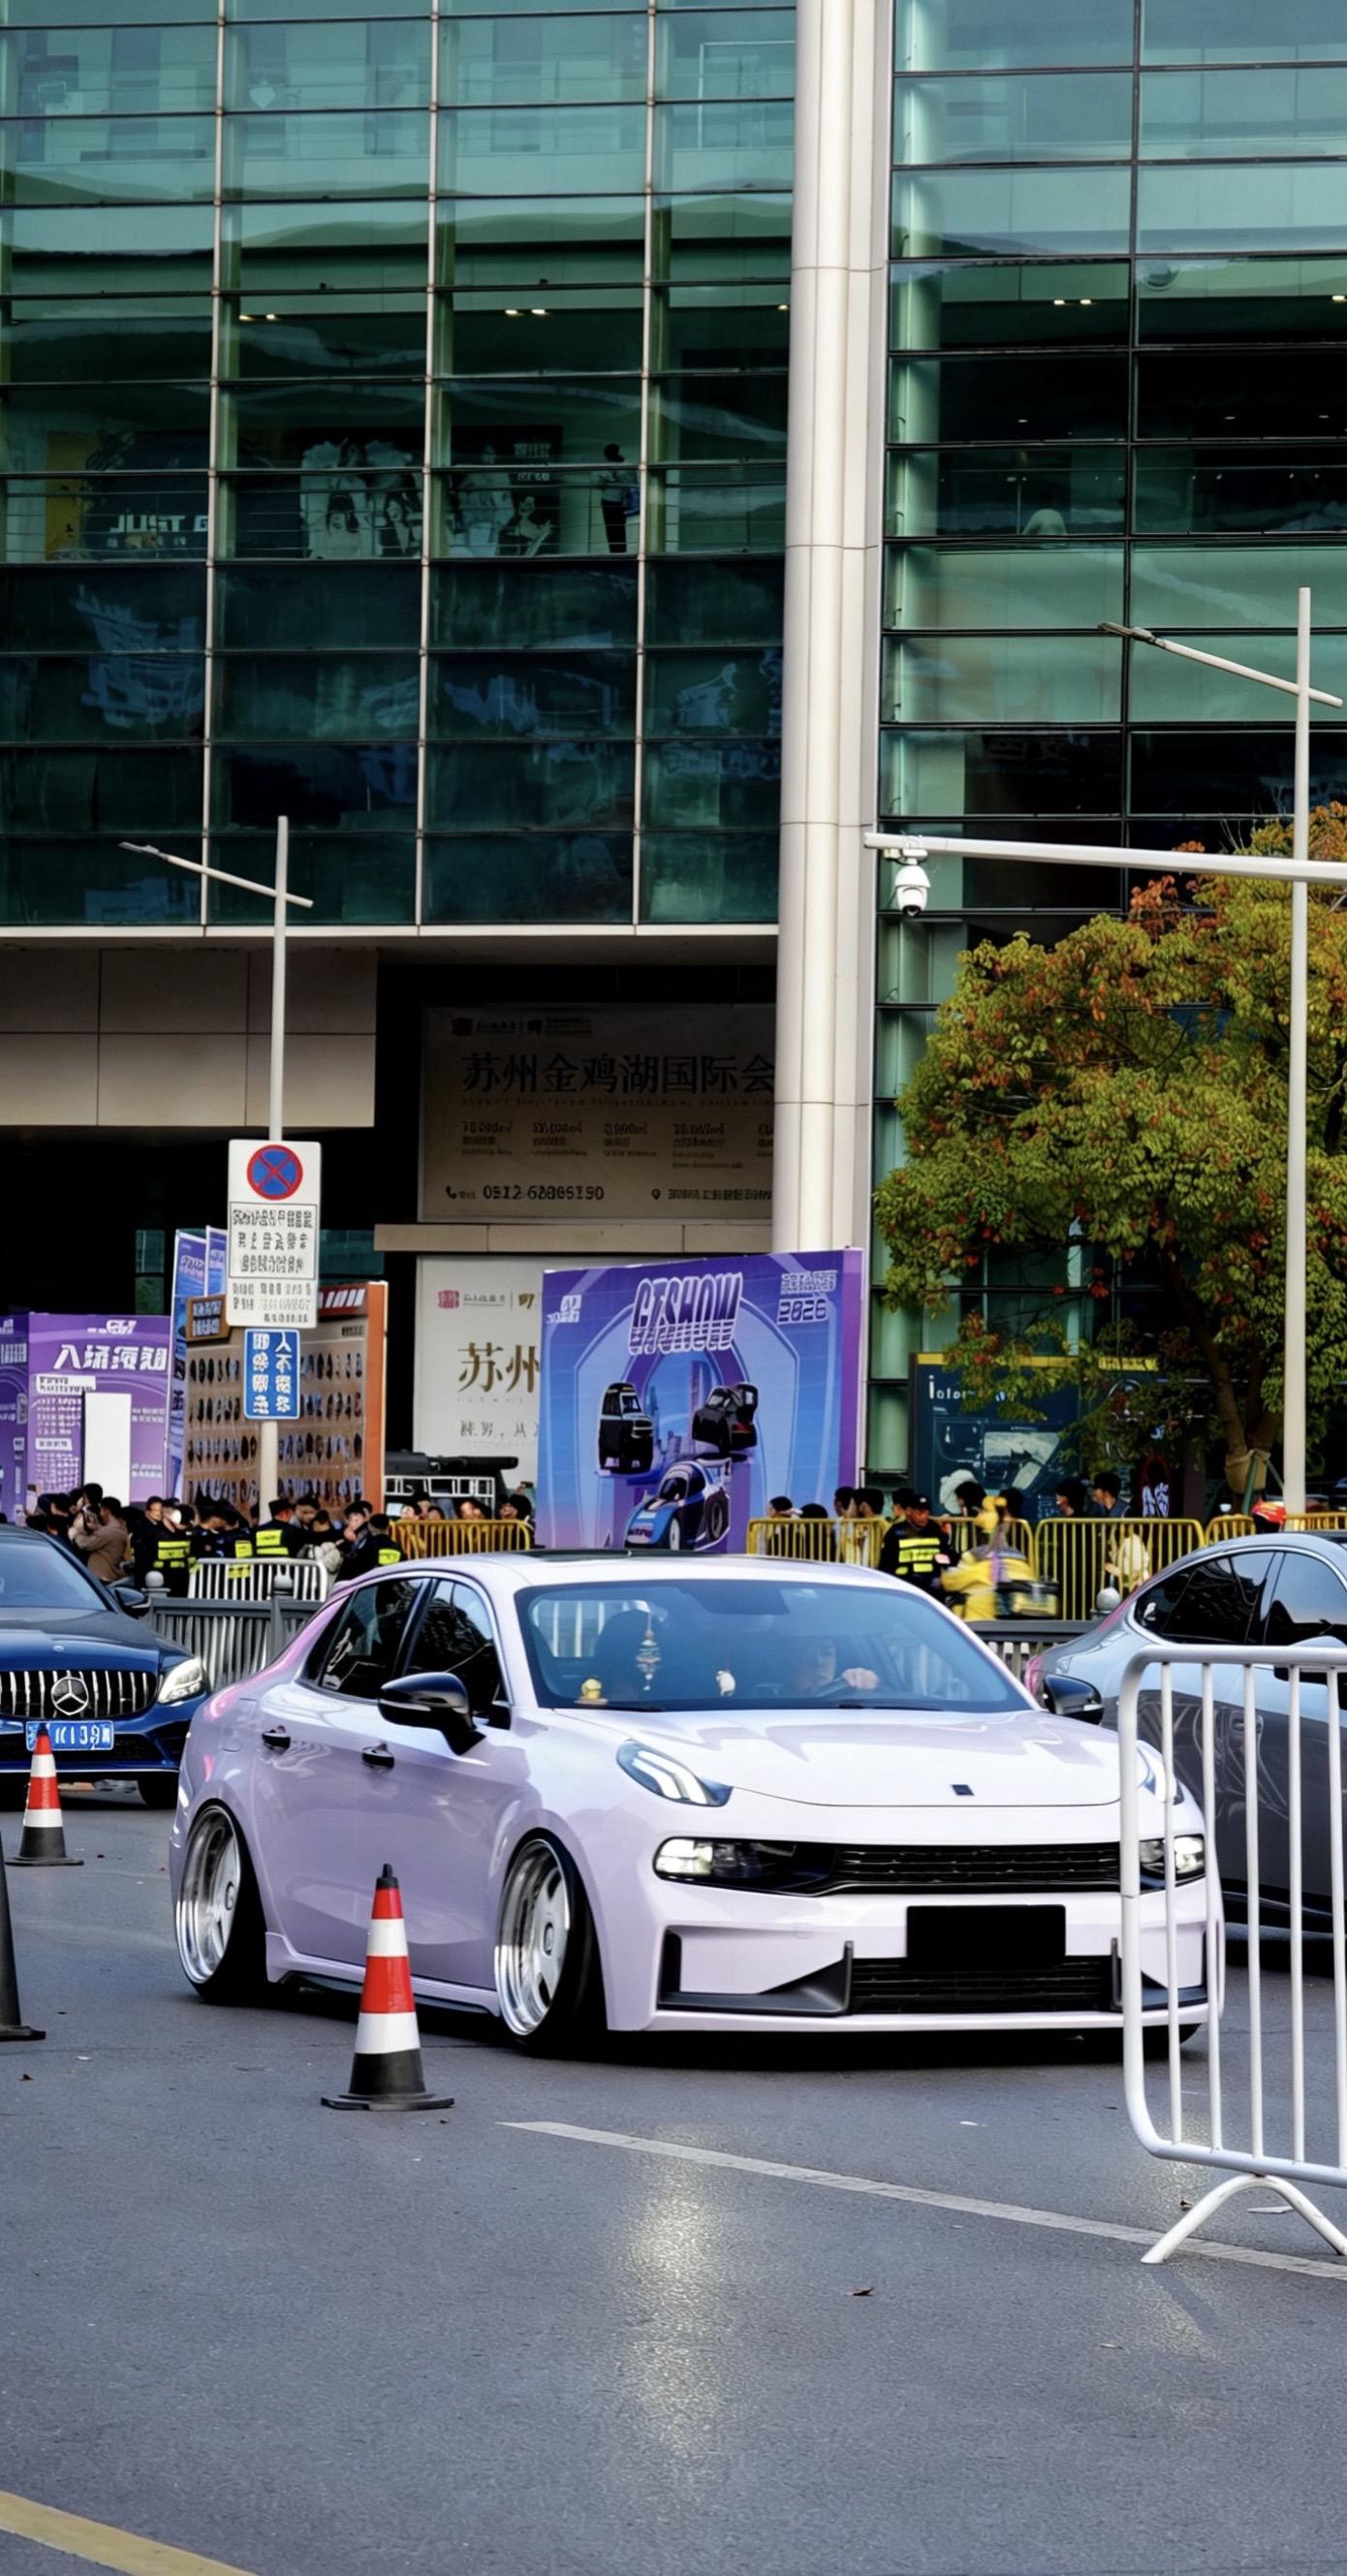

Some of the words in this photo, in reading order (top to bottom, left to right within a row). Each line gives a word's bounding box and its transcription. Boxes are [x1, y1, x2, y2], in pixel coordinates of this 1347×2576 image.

[109, 514, 186, 533] JUST
[461, 1052, 775, 1095] 苏州金鸡湖国际会
[629, 1272, 743, 1355] GTSHOW
[777, 1296, 829, 1325] 2026
[457, 1342, 541, 1394] 苏州
